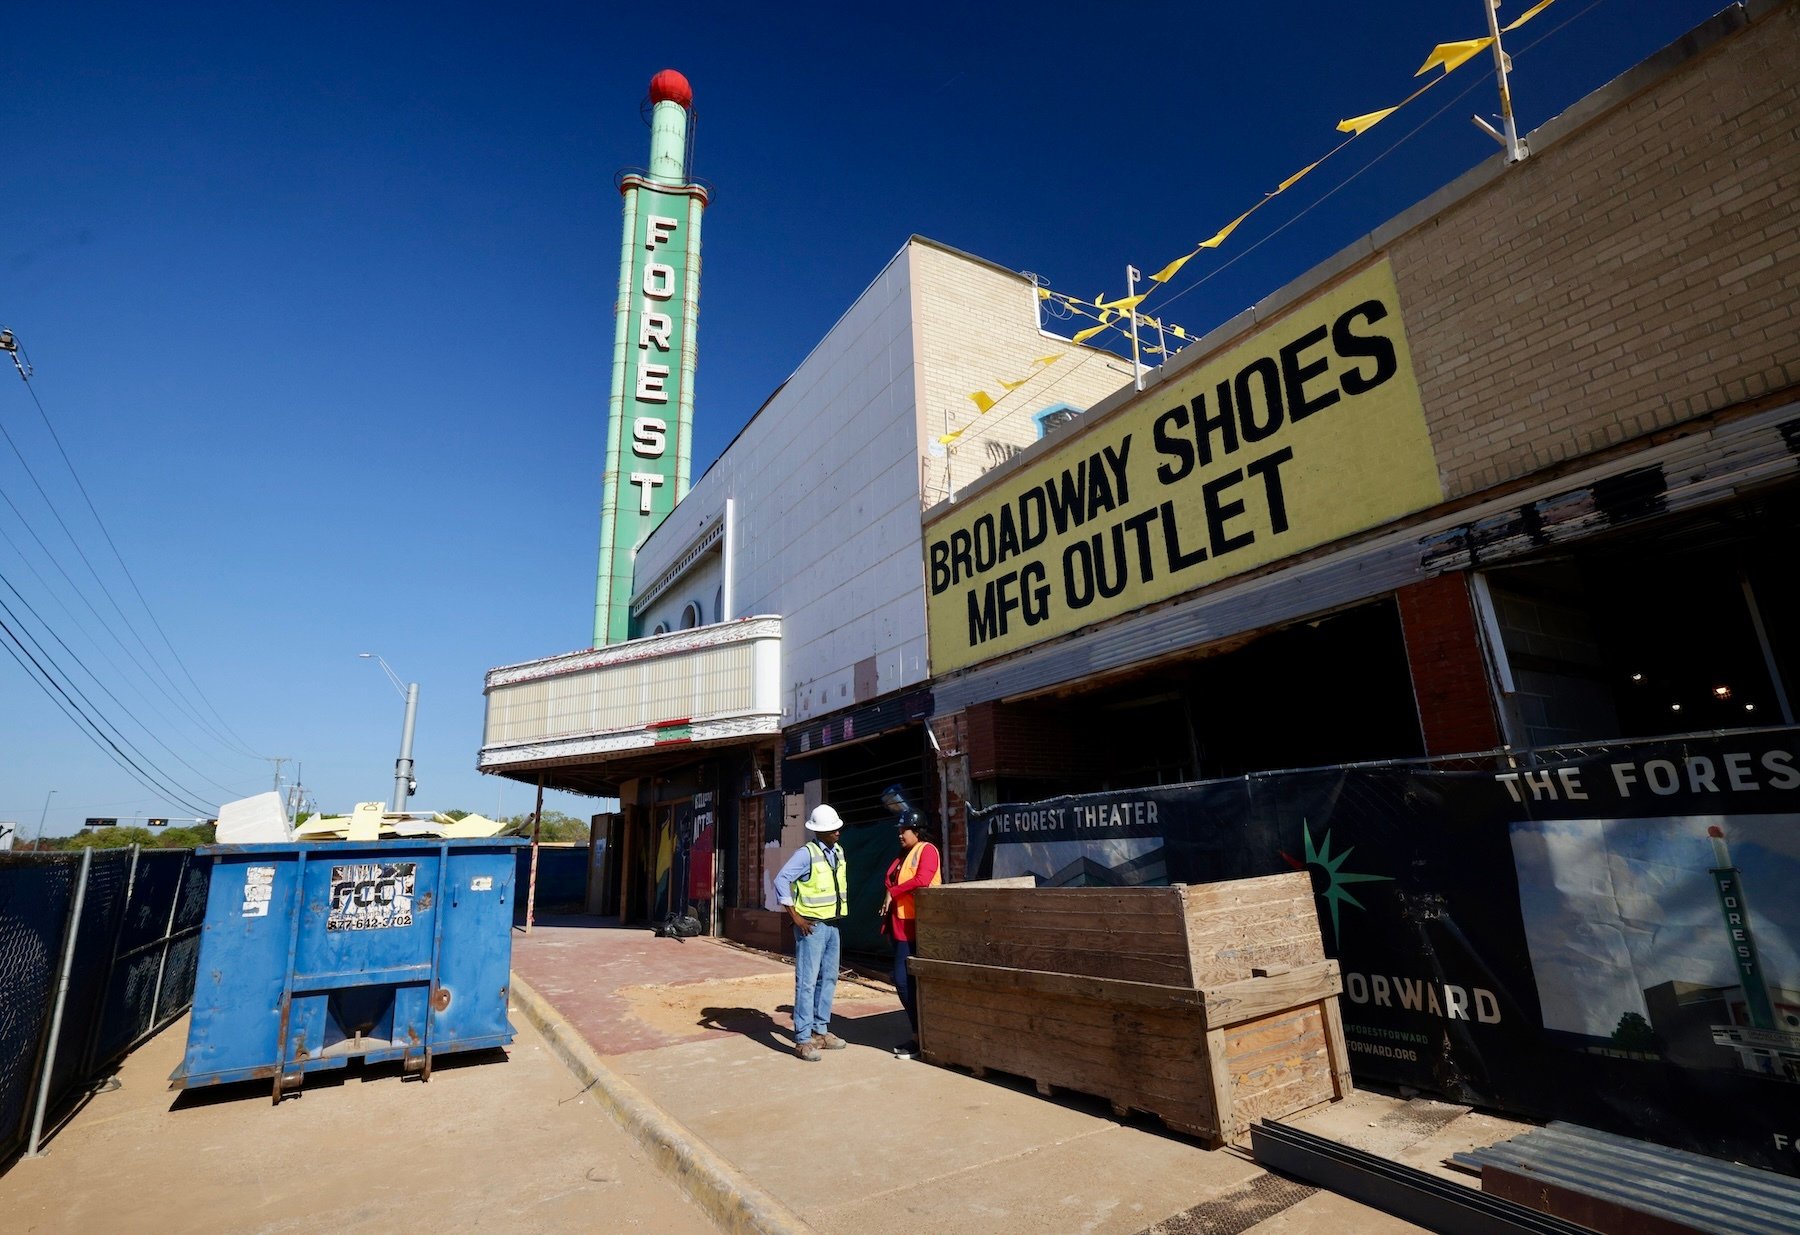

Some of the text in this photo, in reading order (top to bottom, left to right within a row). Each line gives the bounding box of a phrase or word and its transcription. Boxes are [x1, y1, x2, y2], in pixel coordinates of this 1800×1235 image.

[630, 215, 677, 515] FOREST
[930, 300, 1398, 596] BROADWAY SHOES
[968, 446, 1294, 646] MFG OUTLET
[988, 801, 1159, 835] THE FOREST THEATER
[1495, 750, 1800, 802] THE FORES
[1720, 880, 1752, 975] FOREST
